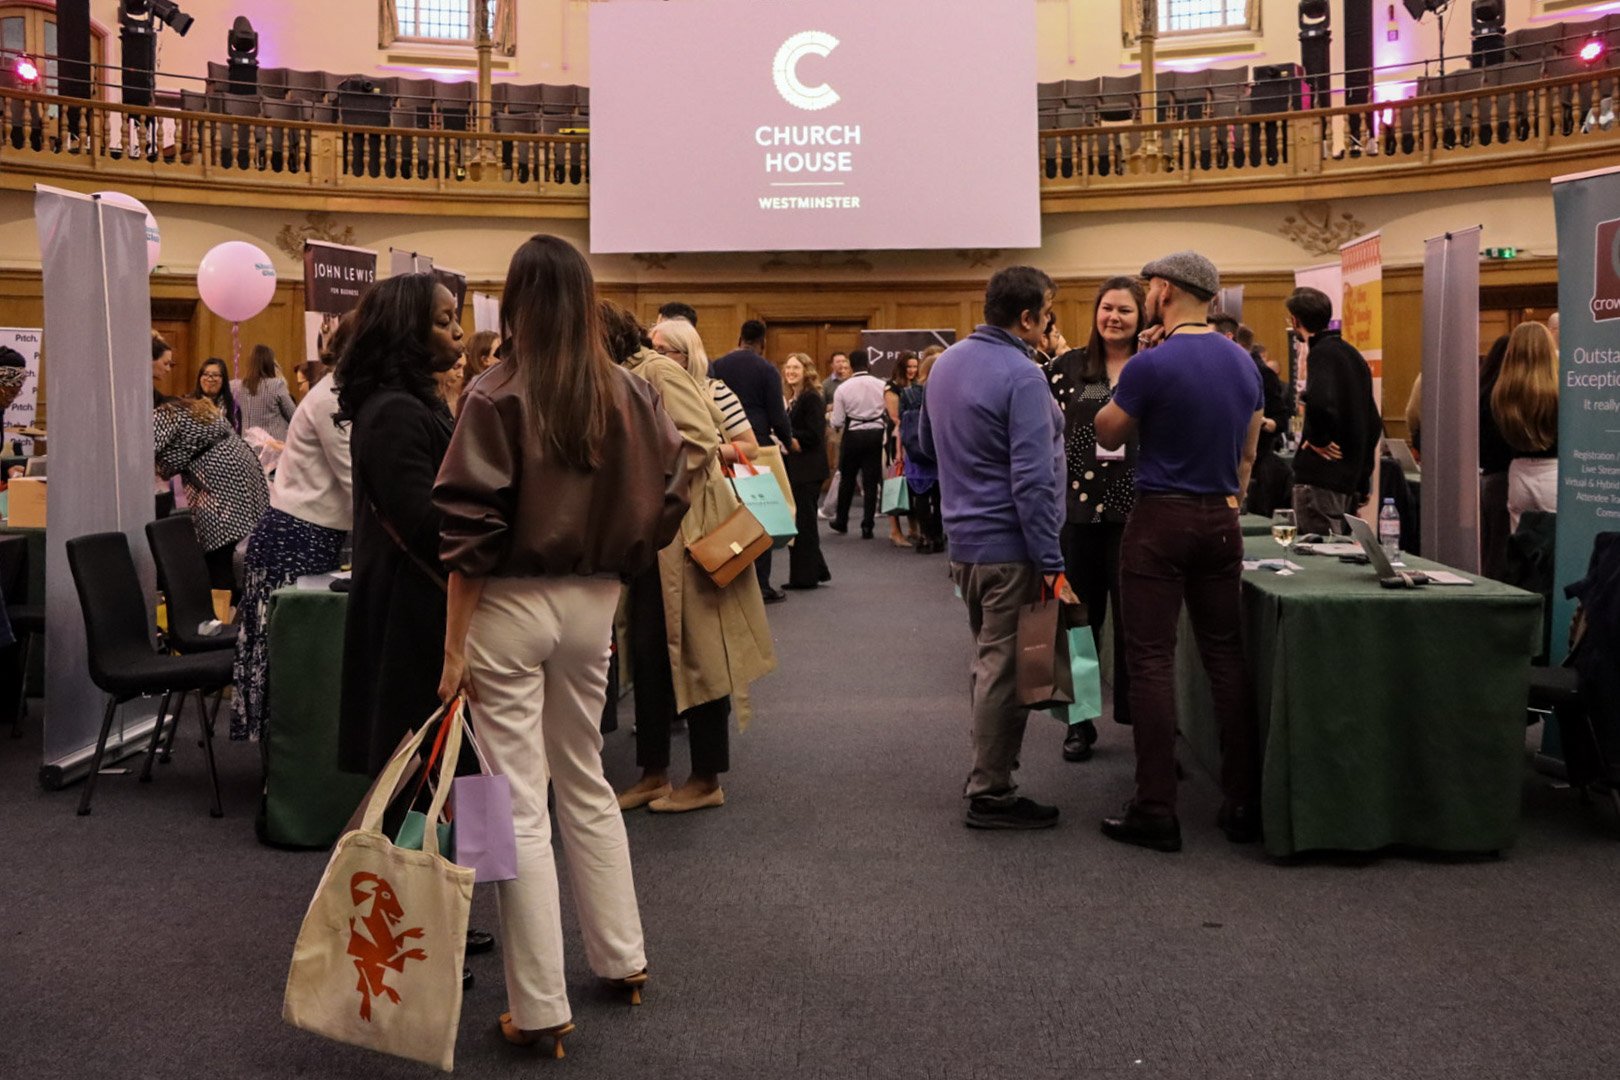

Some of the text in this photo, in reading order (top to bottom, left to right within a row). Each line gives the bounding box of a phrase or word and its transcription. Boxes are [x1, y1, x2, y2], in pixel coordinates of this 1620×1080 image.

[755, 125, 861, 146] CHURCH
[765, 151, 853, 173] HOUSE
[758, 196, 861, 209] WESTMINSTER
[314, 263, 374, 283] JOHN LEWIS
[15, 334, 38, 342] Pitch.
[11, 403, 34, 411] Pitch.
[1584, 399, 1619, 412] It really
[1573, 449, 1616, 461] Registration
[1581, 465, 1597, 474] Live
